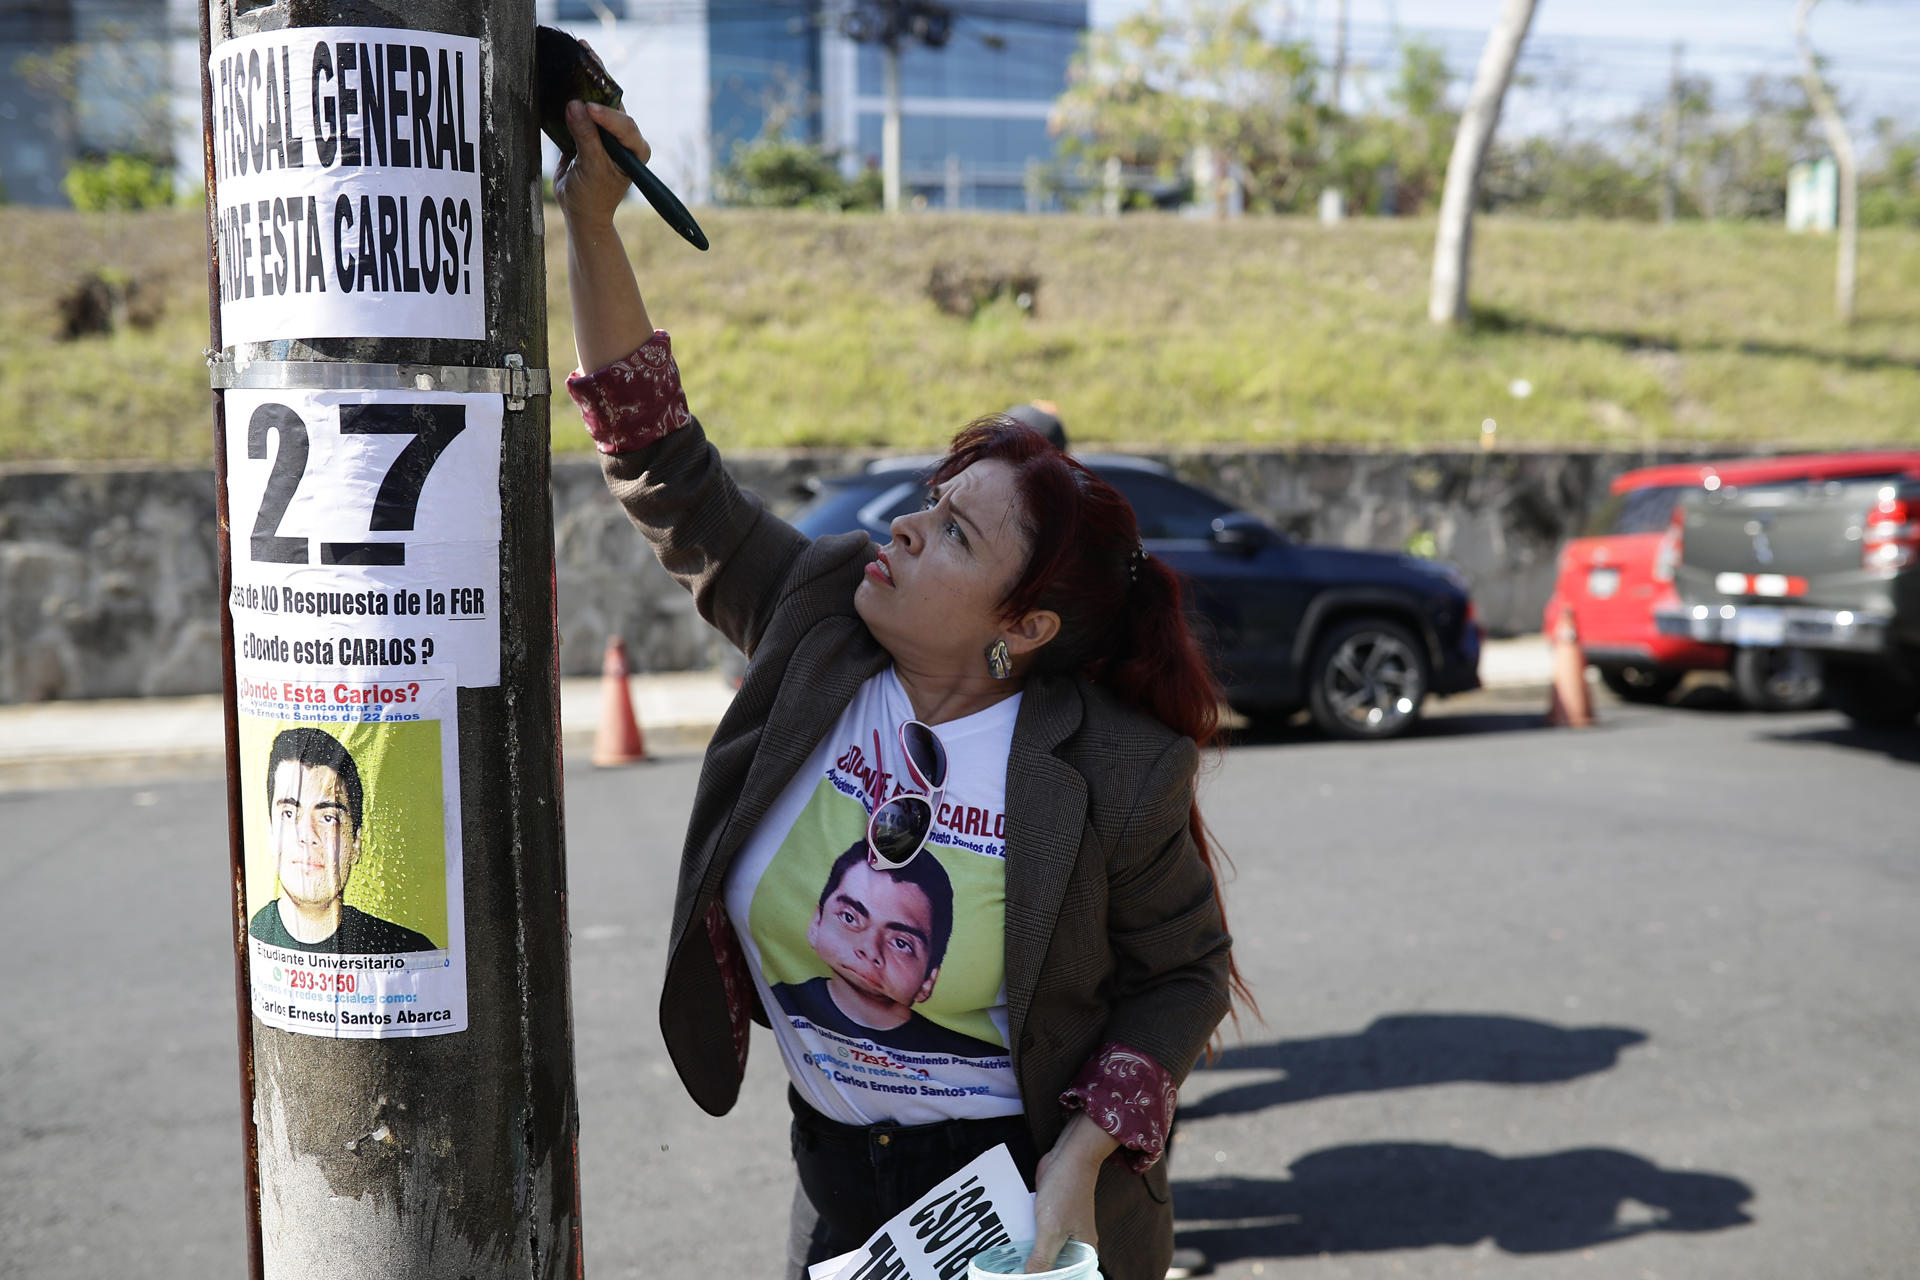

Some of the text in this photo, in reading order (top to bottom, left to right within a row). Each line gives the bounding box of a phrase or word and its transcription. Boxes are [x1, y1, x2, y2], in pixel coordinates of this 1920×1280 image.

[220, 45, 303, 179] FISCAL
[312, 40, 475, 173] GENERAL
[258, 195, 326, 296] ESTA
[333, 193, 473, 295] CARLOS?
[246, 584, 258, 609] de
[261, 585, 279, 612] NO
[282, 586, 388, 617] Respuesta
[393, 588, 421, 615] de
[425, 588, 445, 615] la
[450, 587, 485, 615] FGR
[293, 637, 334, 665] está
[338, 637, 417, 666] CARLOS
[283, 682, 326, 703] Esta
[333, 682, 420, 704] Carlos?
[257, 708, 291, 720] Ernesto
[294, 711, 338, 721] Santos
[342, 713, 359, 721] de
[363, 713, 380, 721] 22
[385, 712, 420, 721] años
[293, 703, 300, 711] a
[304, 703, 370, 712] encontrar
[374, 704, 383, 712] a
[952, 835, 984, 854] Santos
[985, 843, 998, 855] de
[257, 942, 304, 966] Etudiante
[308, 953, 405, 970] Universitario
[284, 968, 355, 993] 7293-3150
[295, 990, 323, 1001] redes
[326, 992, 375, 1004] sociales
[379, 994, 417, 1004] como:
[262, 998, 451, 1025] arlos Ernesto Santos Abarca
[833, 1070, 869, 1090] Carlos
[870, 1080, 917, 1095] Ernesto
[920, 1084, 966, 1097] Santos
